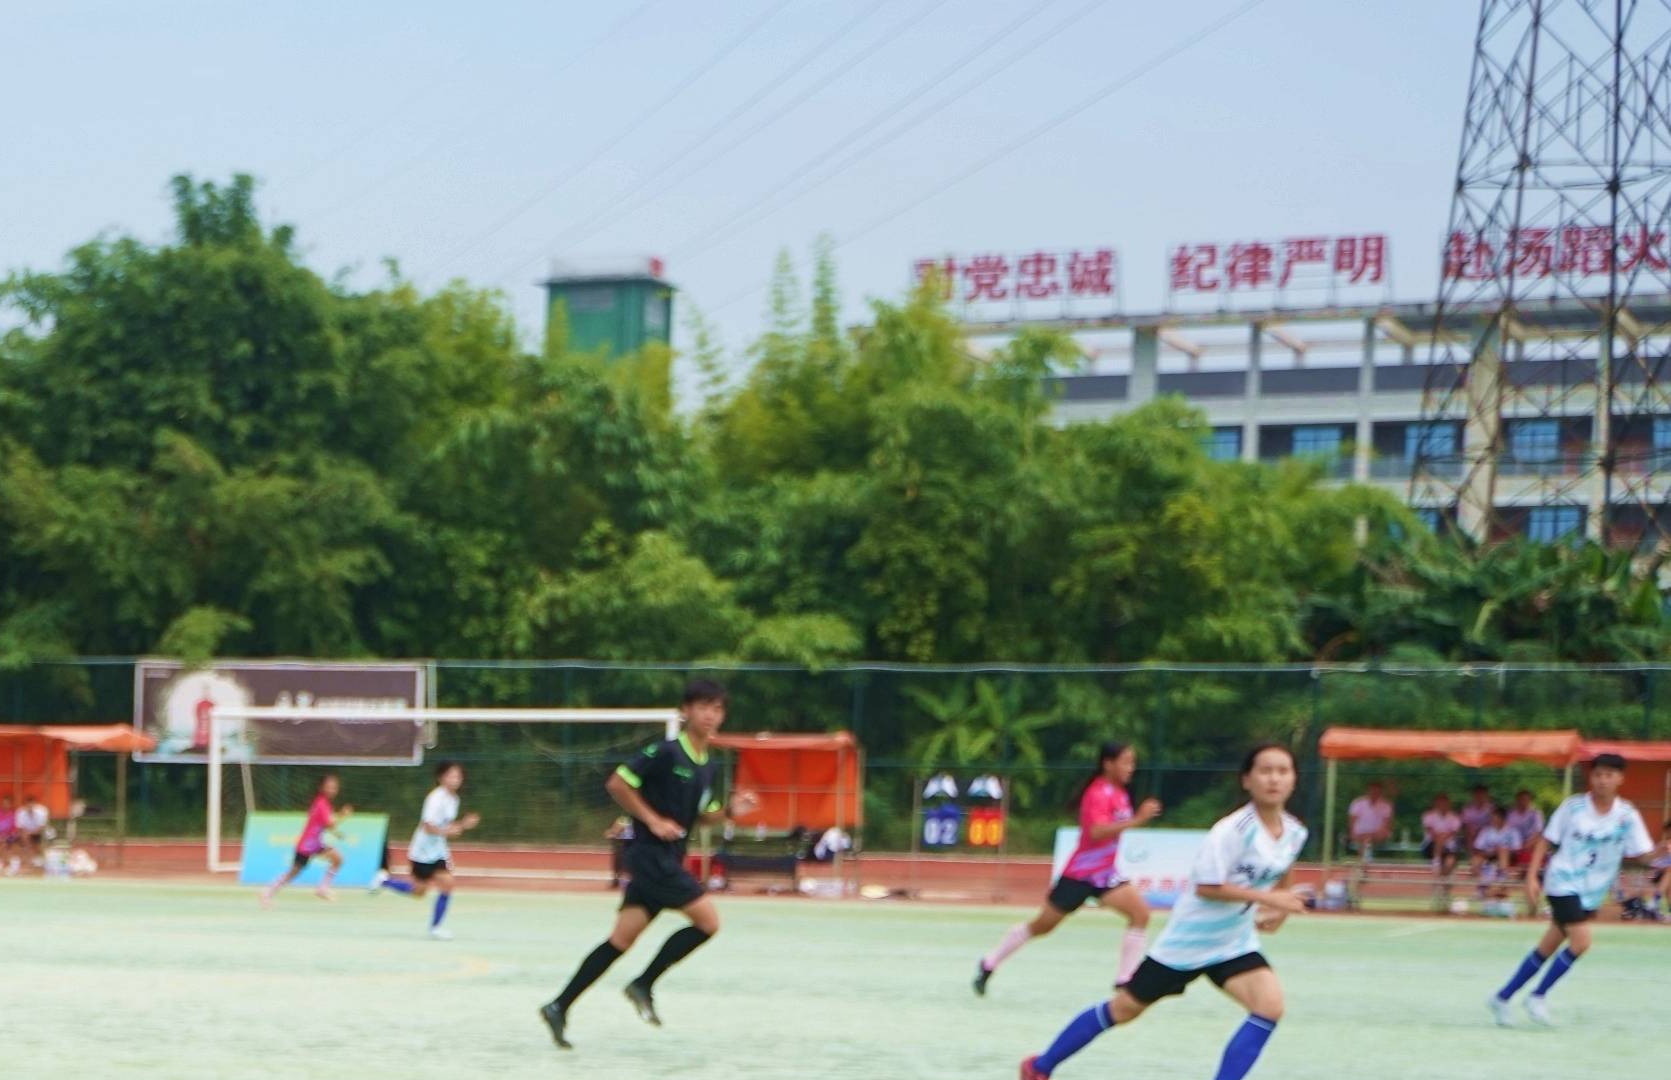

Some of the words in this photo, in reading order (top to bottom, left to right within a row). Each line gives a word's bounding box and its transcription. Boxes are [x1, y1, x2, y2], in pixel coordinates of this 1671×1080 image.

[1170, 235, 1385, 292] 纪律严明
[1444, 224, 1669, 280] 赴汤蹈火
